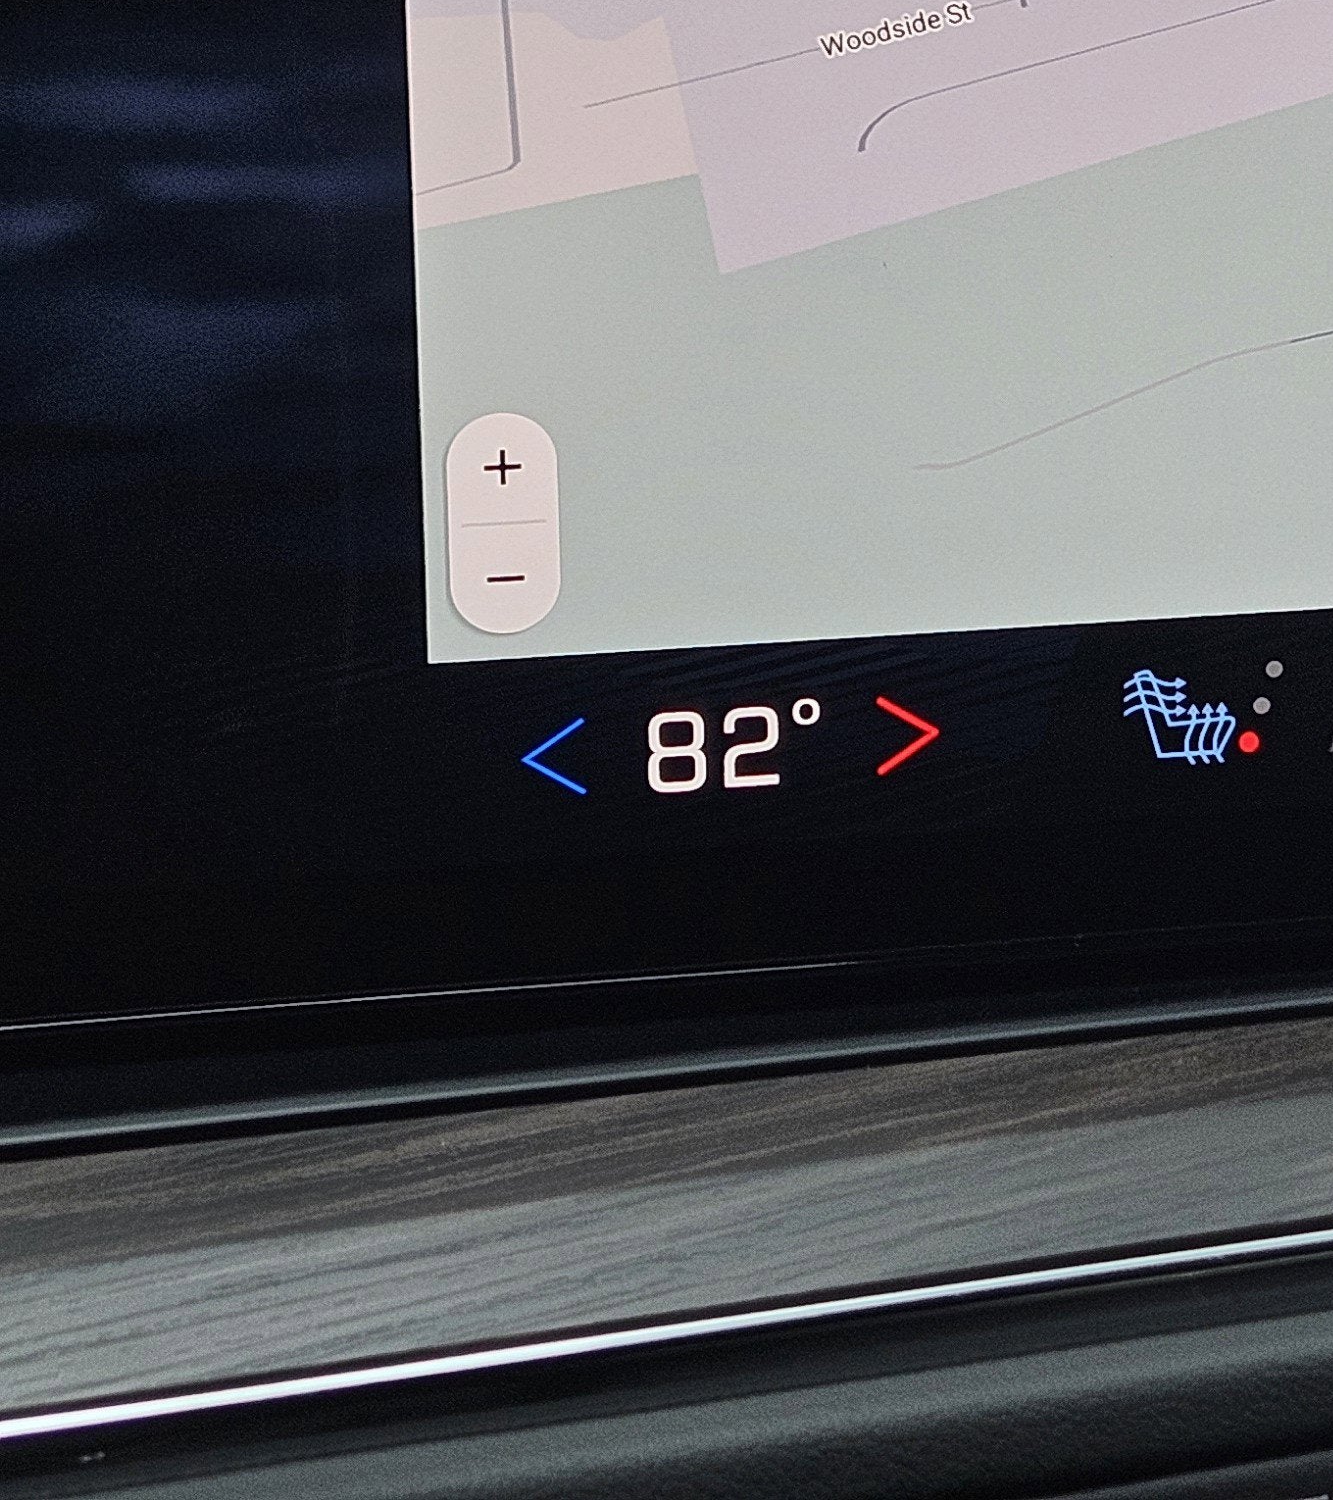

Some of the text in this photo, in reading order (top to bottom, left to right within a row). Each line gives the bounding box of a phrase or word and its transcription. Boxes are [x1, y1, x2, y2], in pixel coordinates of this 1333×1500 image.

[819, 2, 972, 57] Woodside St
[647, 697, 821, 794] 82°
